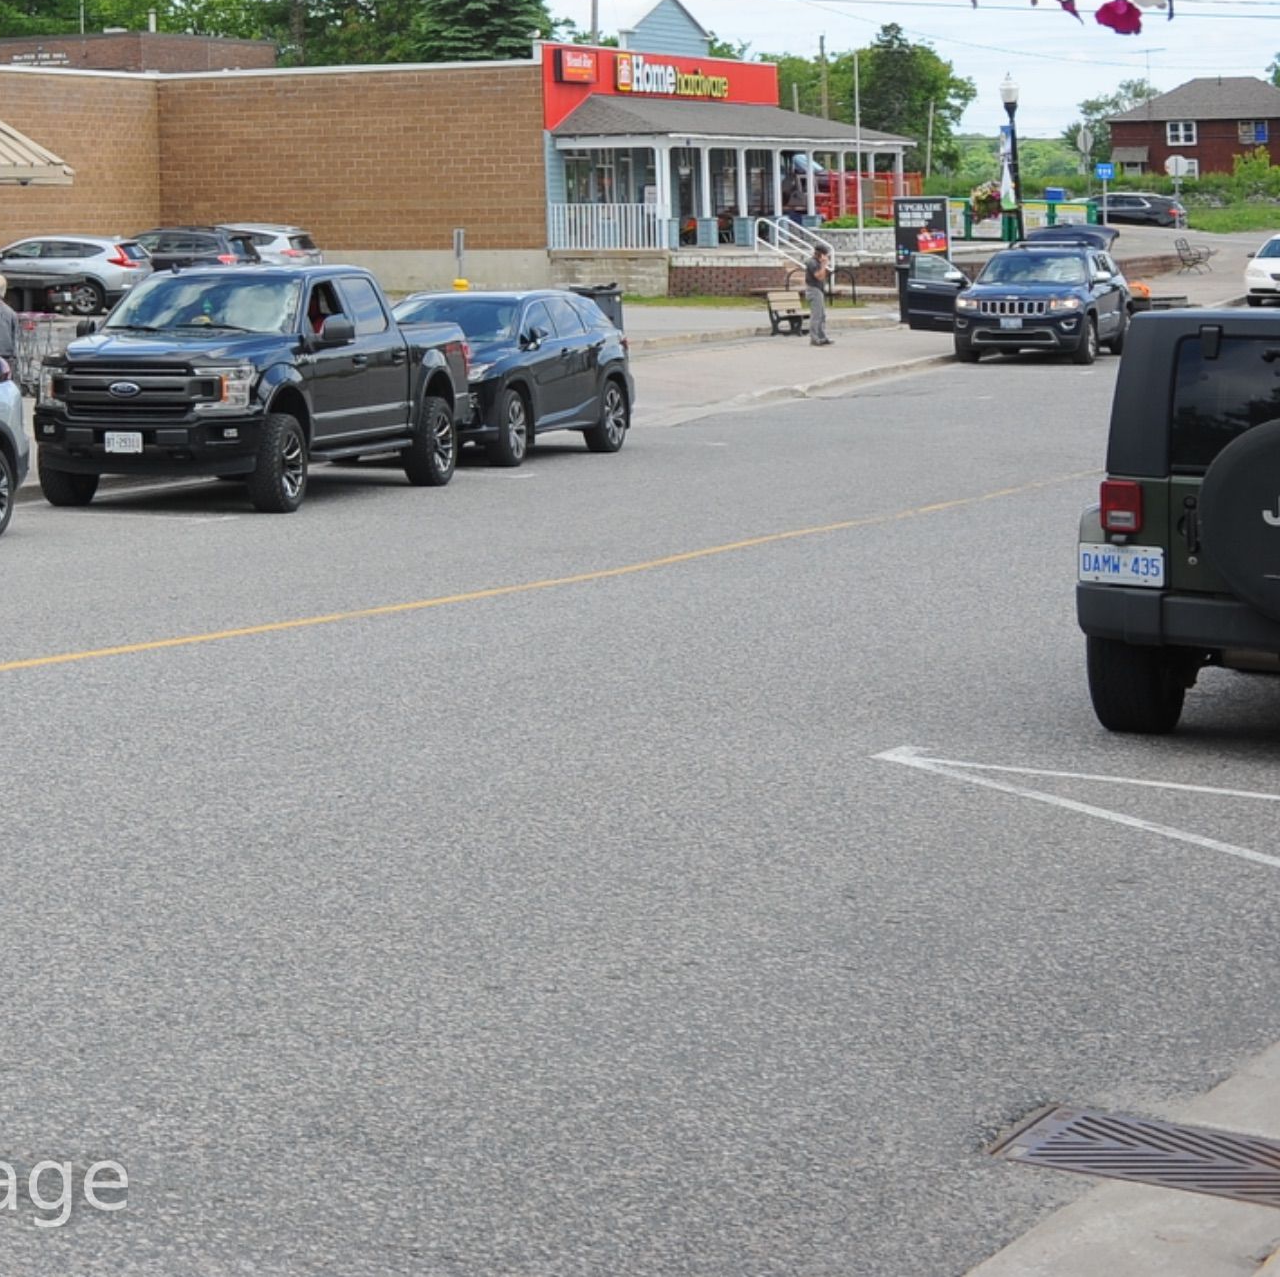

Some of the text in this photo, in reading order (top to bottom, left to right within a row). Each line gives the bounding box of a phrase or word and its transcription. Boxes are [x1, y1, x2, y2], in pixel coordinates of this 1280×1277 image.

[631, 55, 676, 94] Home
[676, 66, 728, 98] hardware
[1082, 552, 1161, 577] DAMW 435
